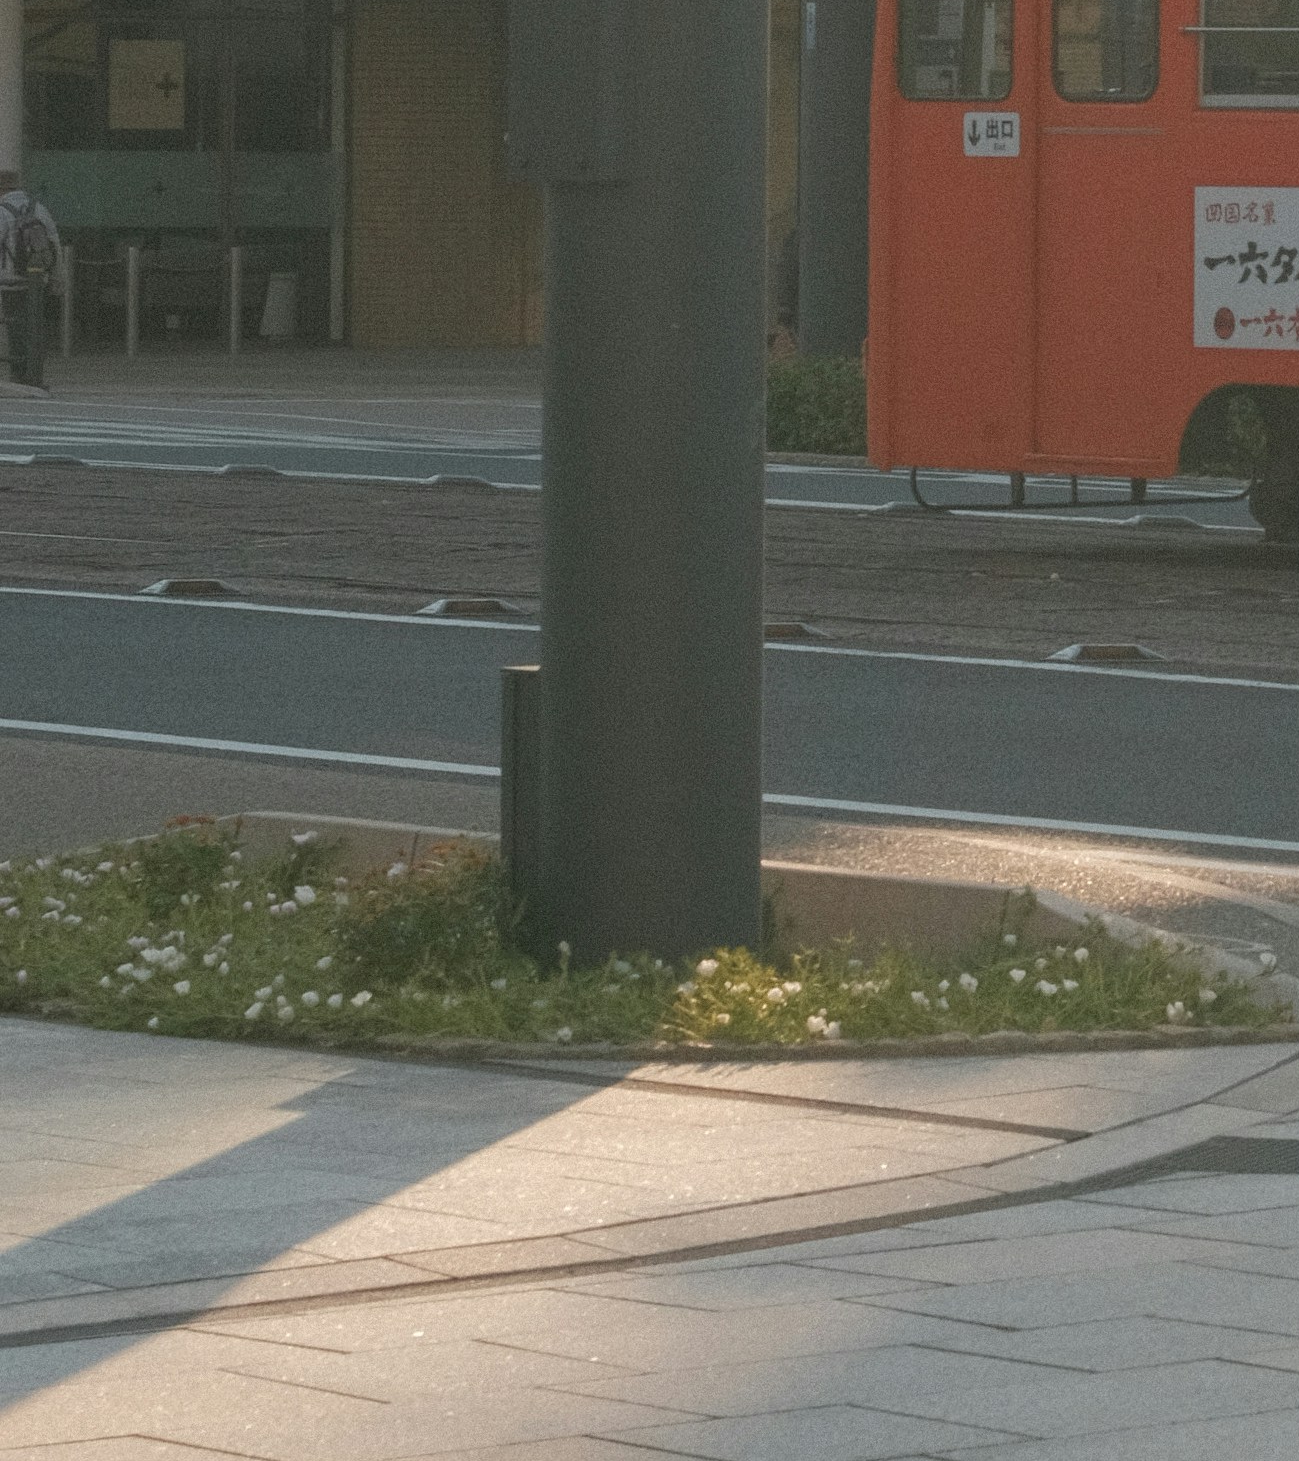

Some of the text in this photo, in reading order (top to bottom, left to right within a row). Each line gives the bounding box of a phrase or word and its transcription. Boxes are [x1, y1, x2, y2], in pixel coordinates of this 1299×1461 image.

[985, 118, 1014, 138] 出口
[1205, 200, 1276, 226] 四国名菓
